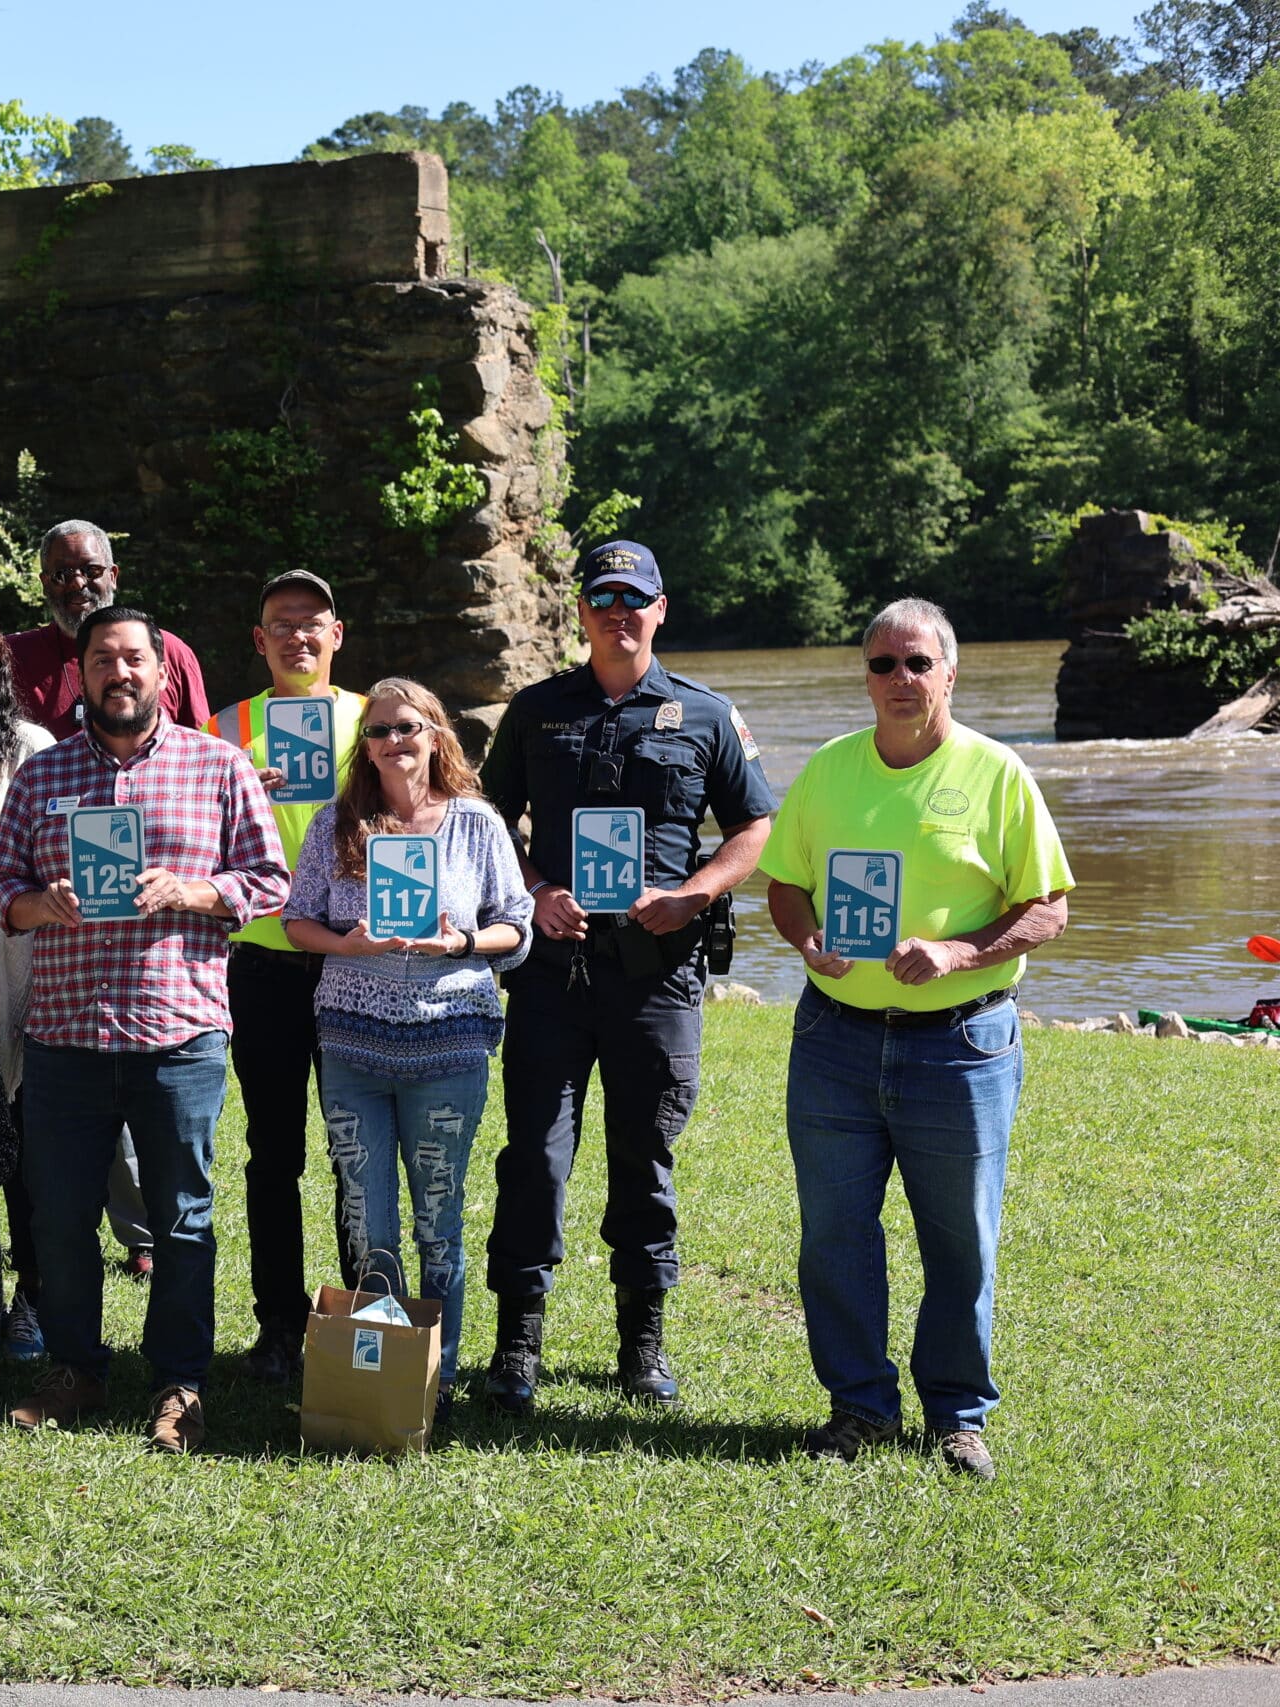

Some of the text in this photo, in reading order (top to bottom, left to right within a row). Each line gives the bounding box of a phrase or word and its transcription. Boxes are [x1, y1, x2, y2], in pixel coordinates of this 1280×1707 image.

[601, 563, 636, 571] ALABAMA
[274, 741, 291, 749] MILE
[275, 750, 329, 780] 116
[79, 854, 96, 862] MILE
[582, 861, 636, 889] 114
[80, 864, 137, 896] 125
[581, 891, 618, 899] Tallapoosa
[834, 894, 852, 902] MILE
[81, 898, 119, 906] Tallapoosa
[377, 889, 431, 917] 117
[835, 906, 891, 937] 115
[832, 937, 871, 945] Tallapoosa
